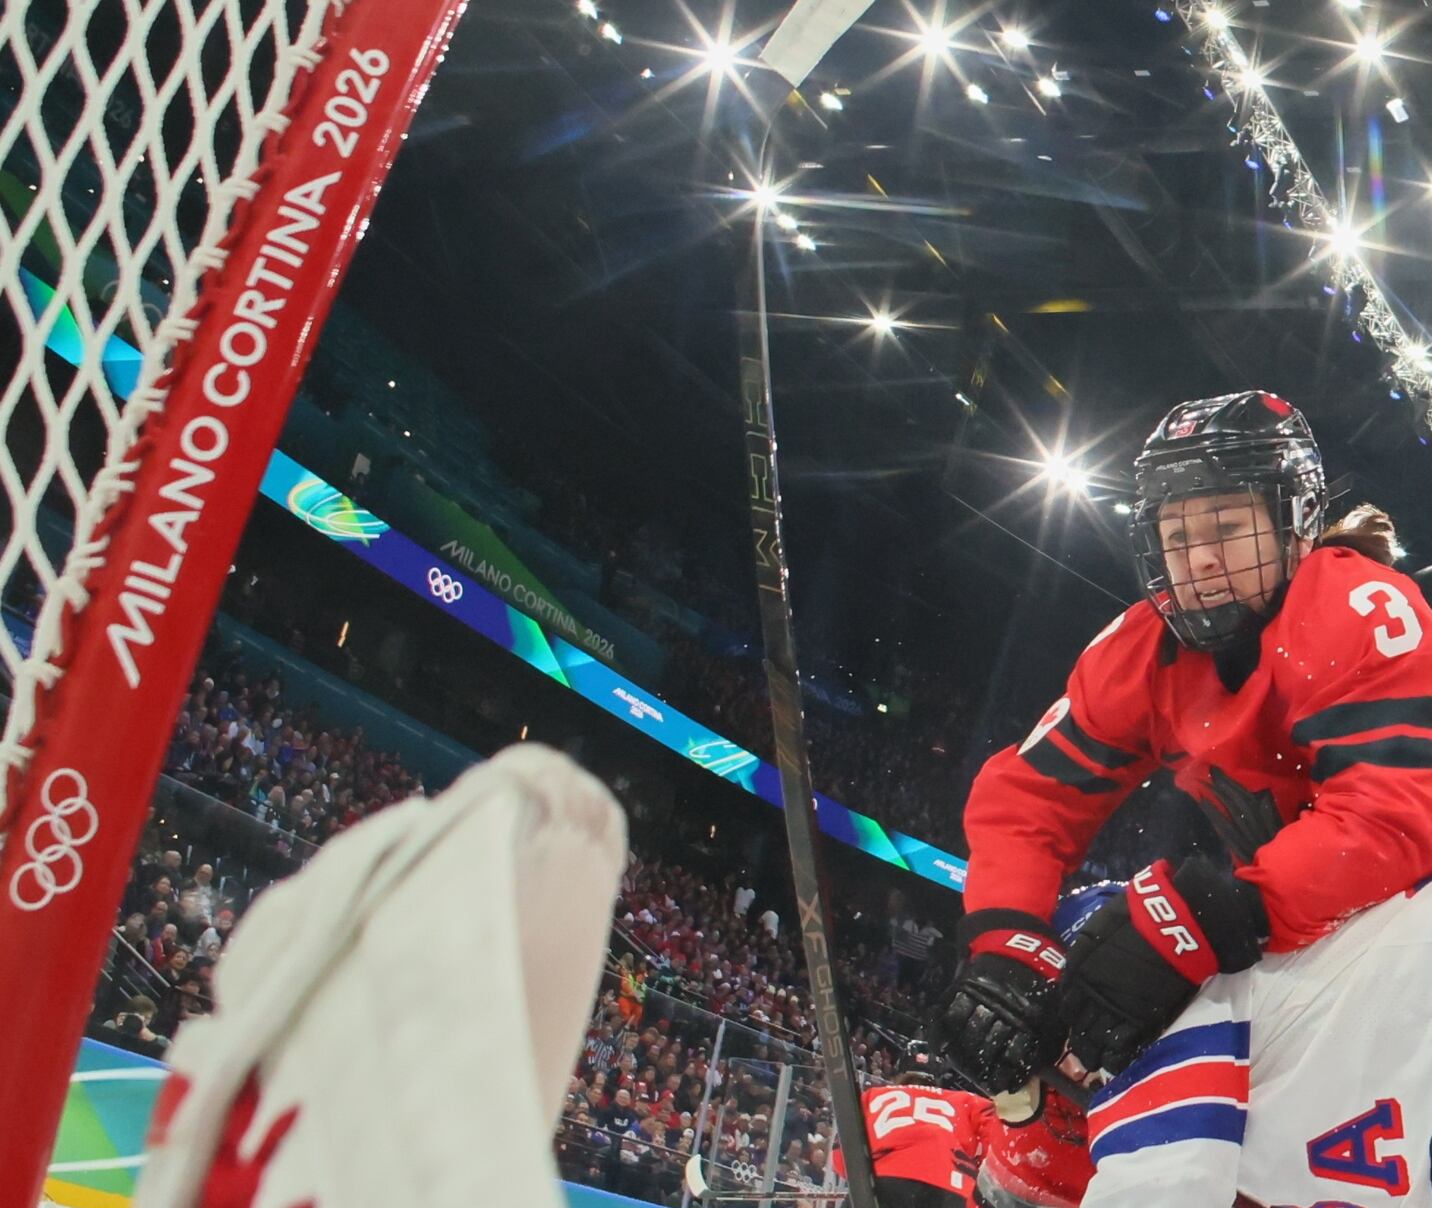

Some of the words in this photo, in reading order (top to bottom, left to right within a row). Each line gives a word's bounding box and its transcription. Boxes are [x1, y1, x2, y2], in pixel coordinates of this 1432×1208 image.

[105, 416, 230, 689] MILANO
[202, 171, 342, 408] CORTINA
[313, 47, 390, 158] 2026
[440, 539, 512, 592] MILANO
[513, 583, 579, 640] CORTINA
[583, 628, 616, 660] 2026
[1348, 580, 1424, 658] 3
[1133, 867, 1199, 956] UER
